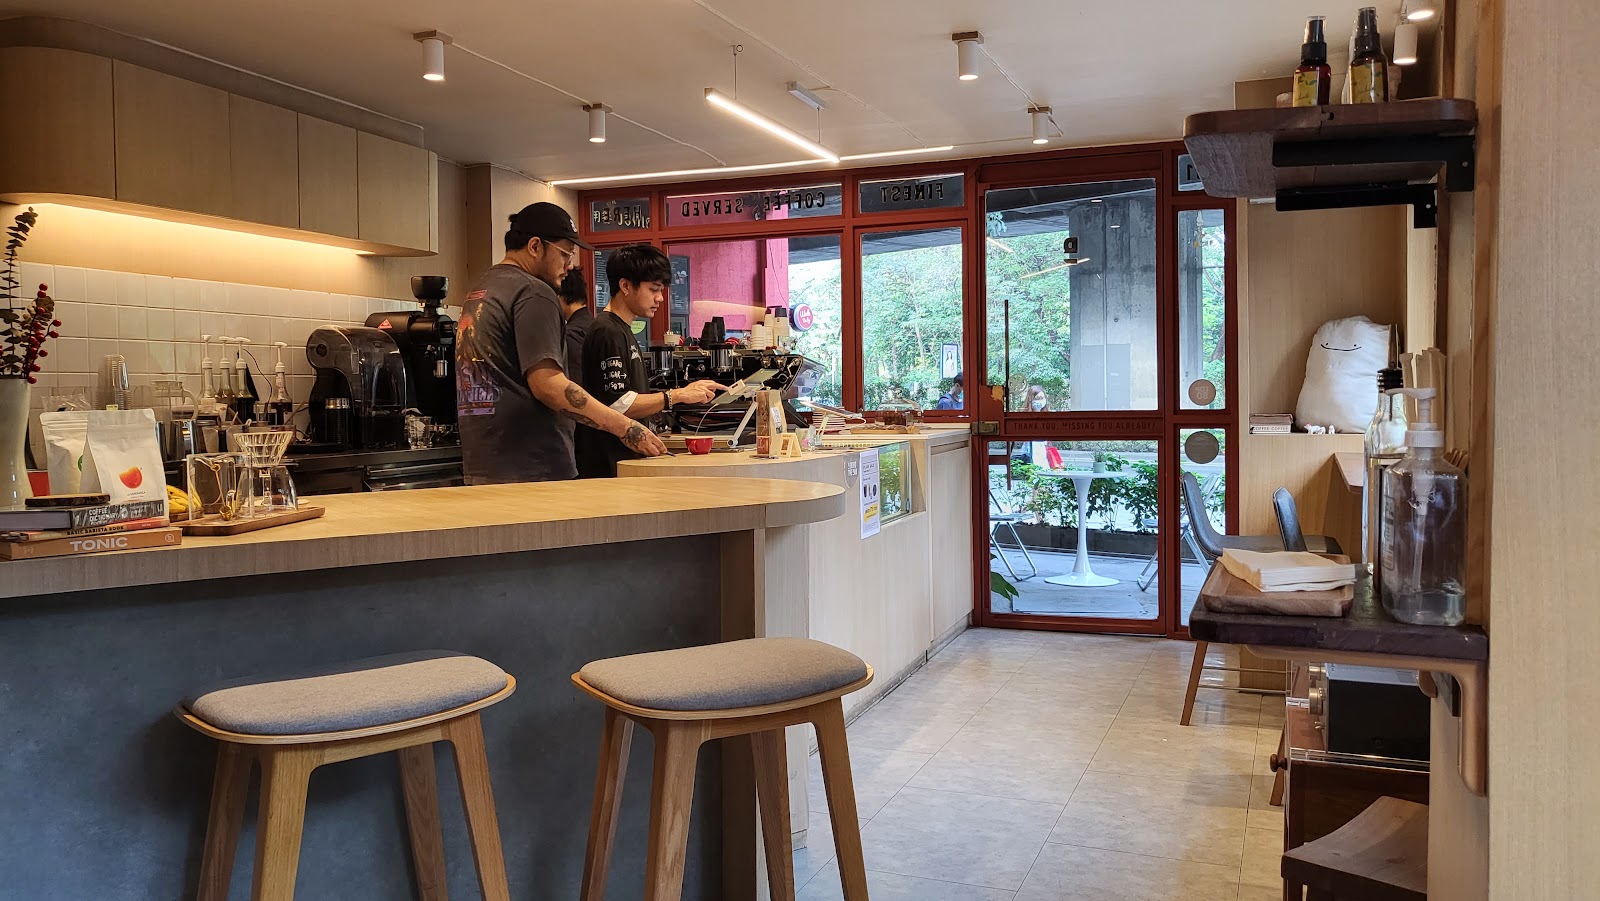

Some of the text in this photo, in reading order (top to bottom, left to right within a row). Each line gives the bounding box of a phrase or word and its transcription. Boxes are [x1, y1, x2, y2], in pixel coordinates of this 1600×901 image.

[1014, 422, 1039, 431] THANK
[1098, 422, 1113, 431] YOU
[70, 537, 128, 552] TONIC
